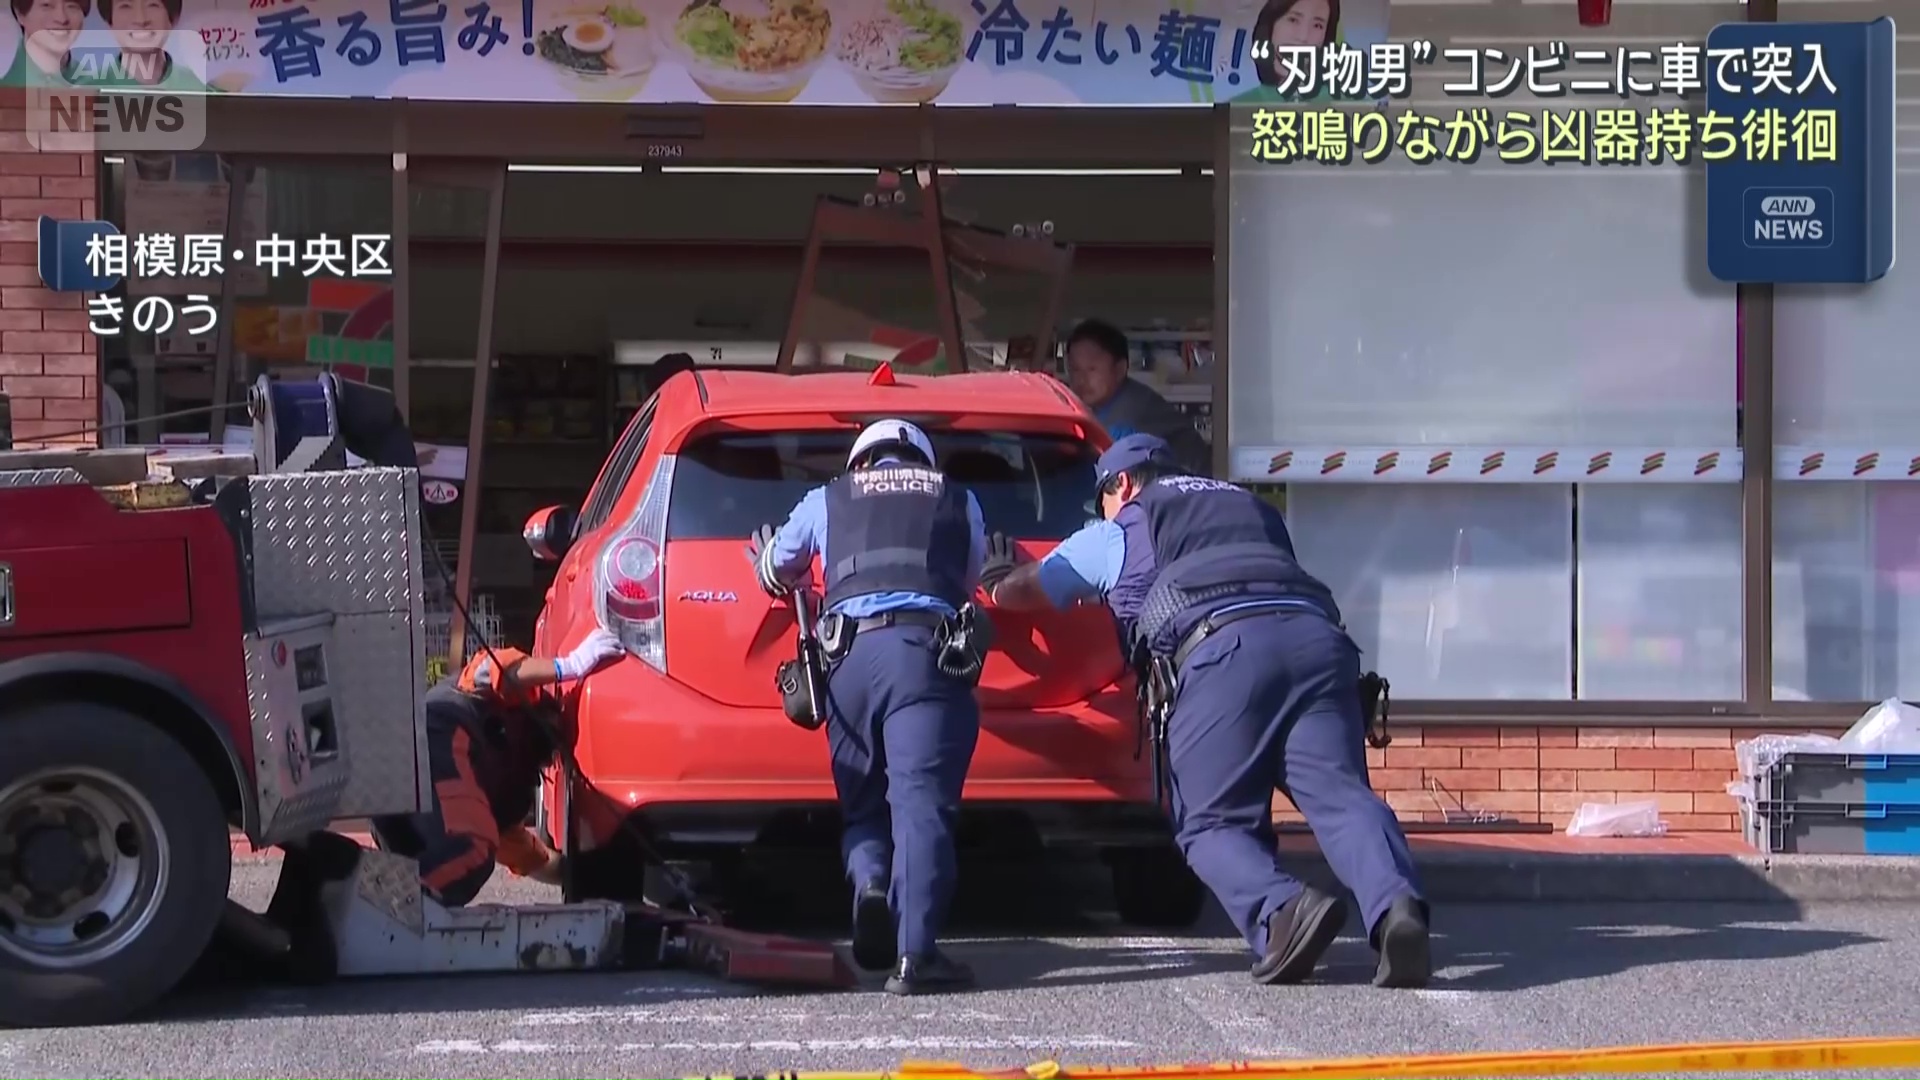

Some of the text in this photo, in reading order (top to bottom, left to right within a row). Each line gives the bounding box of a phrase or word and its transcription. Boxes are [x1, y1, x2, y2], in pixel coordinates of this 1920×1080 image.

[965, 0, 1248, 86] 冷たい麺!
[648, 145, 682, 157] 237943
[863, 480, 935, 495] POLICE
[677, 590, 738, 603] AQUA
